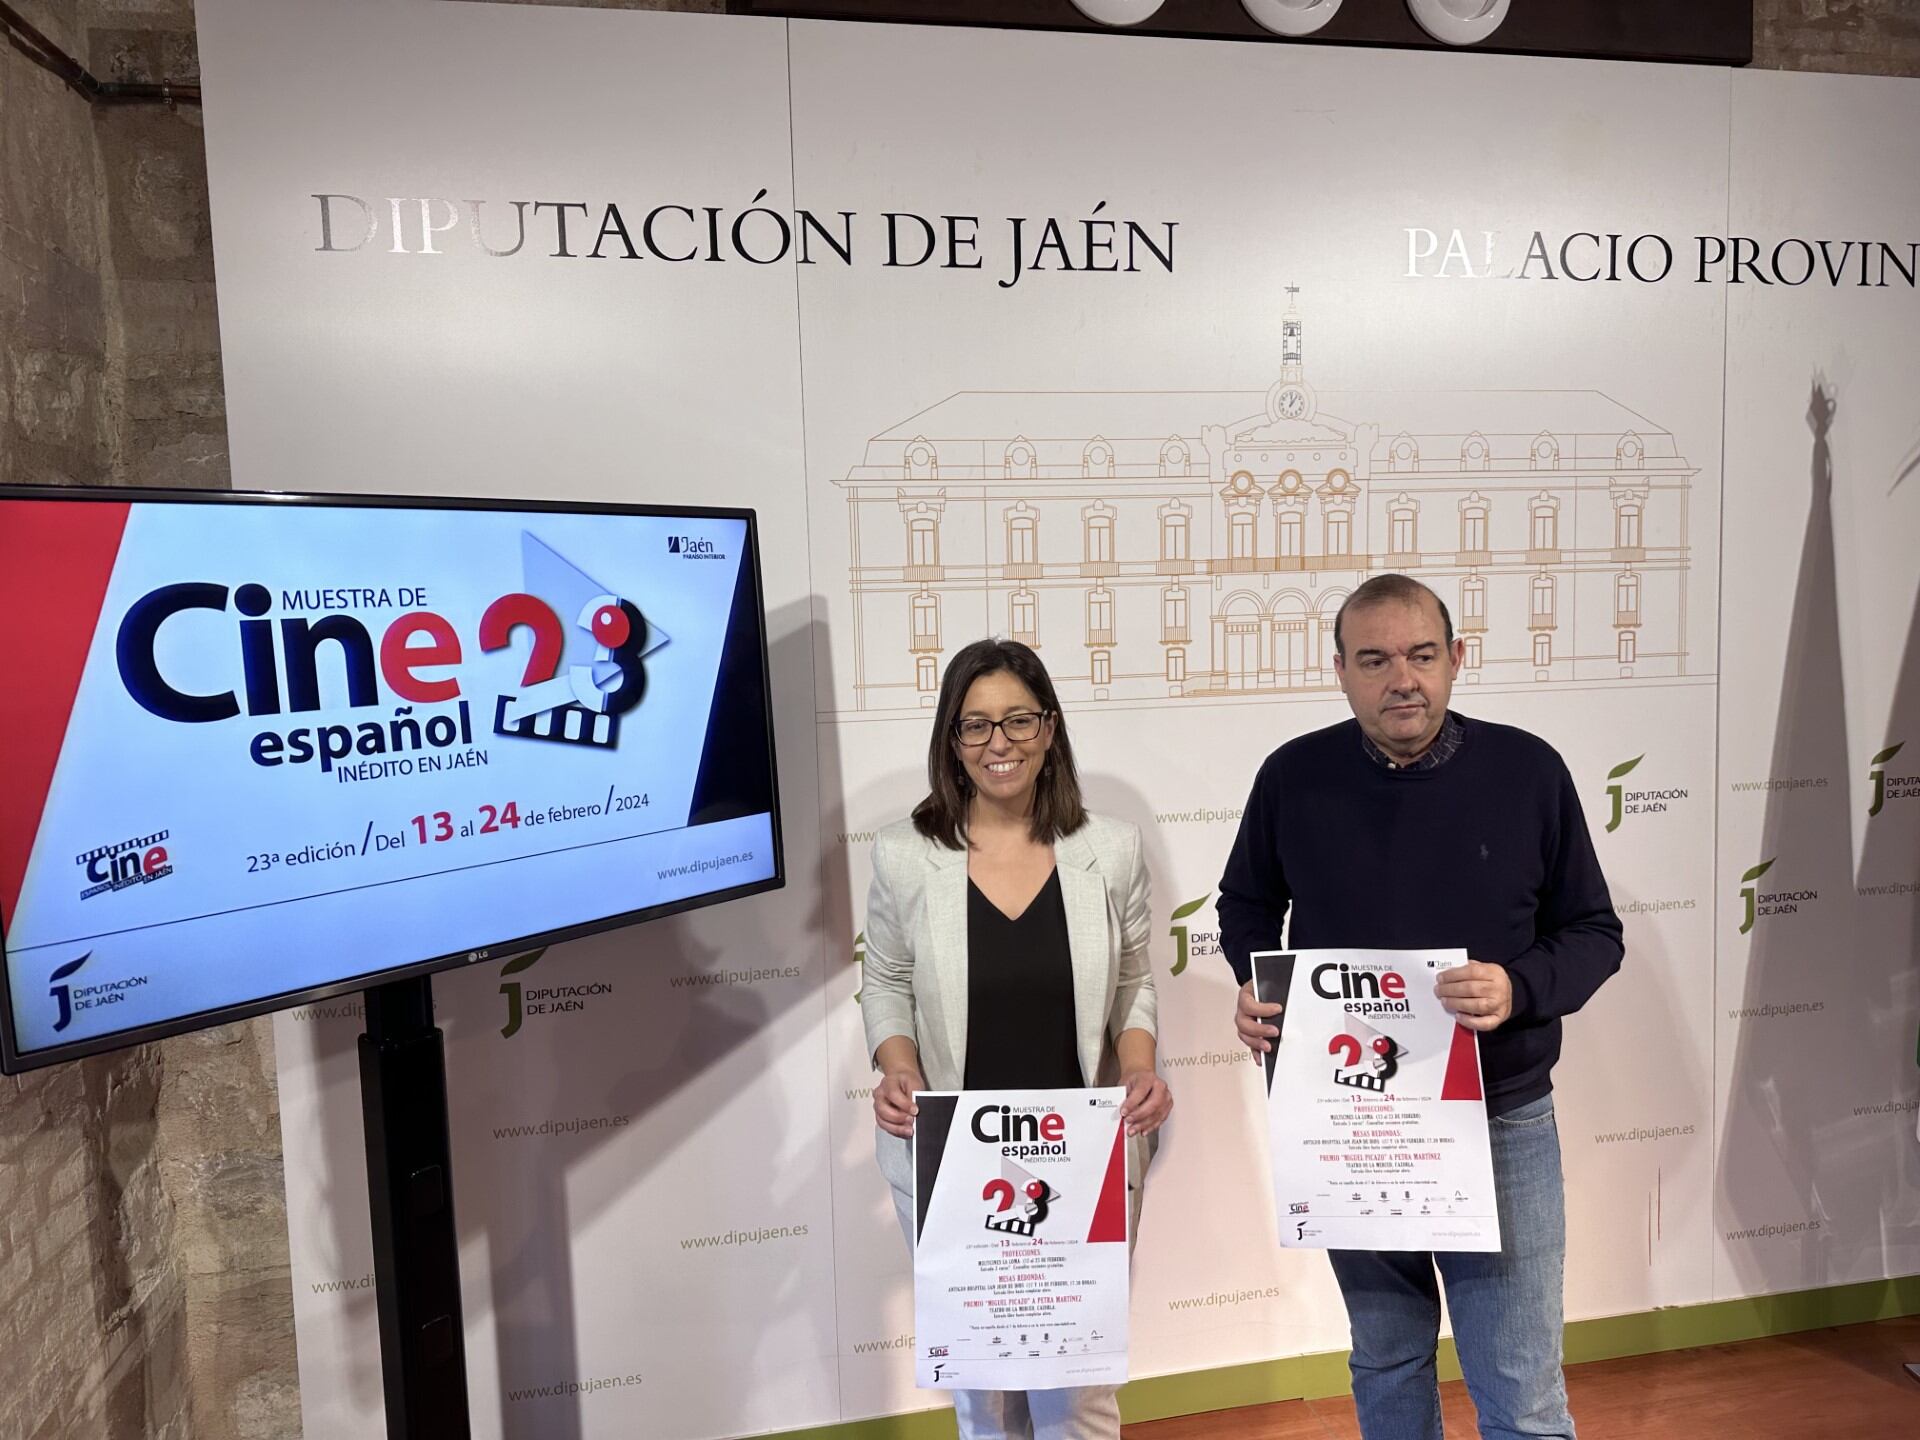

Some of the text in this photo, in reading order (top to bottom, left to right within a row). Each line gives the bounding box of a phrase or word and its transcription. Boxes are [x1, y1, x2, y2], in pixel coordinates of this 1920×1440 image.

[311, 188, 1180, 289] DIPUTACIÓN DE JAÉN
[1403, 228, 1673, 282] PALACIO
[281, 587, 427, 610] MUESTRA DE
[116, 582, 462, 723] Cine
[250, 700, 472, 773] español
[338, 748, 488, 783] INÉDITO EN JAÉN
[1731, 775, 1829, 793] www.dipujaen.es
[1624, 788, 1688, 802] DIPUTACIÓN
[1156, 808, 1243, 824] www.dipujae
[1624, 801, 1667, 814] DE JAÉN
[285, 842, 356, 866] edición
[375, 830, 406, 852] Del
[411, 811, 454, 845] 13
[460, 820, 474, 838] al
[479, 801, 521, 834] 24
[524, 810, 545, 826] de
[548, 804, 601, 823] febrero
[615, 793, 650, 812] 2024
[657, 850, 754, 881] www.dipujaen.es
[1613, 899, 1696, 915] w.dipujaen.es
[1758, 890, 1818, 903] DIPUTACIÓN
[1758, 903, 1797, 915] DE JAÉN
[1191, 932, 1222, 943] DIPU
[1191, 946, 1207, 956] DE
[73, 976, 148, 999] DIPUTACIÓN
[670, 966, 800, 988] www.dipujaen.es
[1311, 963, 1406, 999] Cine
[75, 993, 124, 1011] DE JAÉN
[526, 982, 612, 1001] DIPUTACIÓN
[527, 1000, 585, 1016] DE JAÉN
[1344, 999, 1410, 1016] español
[1728, 1000, 1825, 1019] www.dipujaen.es
[1351, 1094, 1362, 1102] 13
[1384, 1094, 1395, 1102] 24
[493, 1114, 630, 1140] www.dipujaen.es
[971, 1104, 1065, 1143] Cine
[1594, 1123, 1695, 1144] www.dipujaen.es
[1001, 1141, 1067, 1159] español
[681, 1223, 809, 1249] www.dipujaen.es
[1726, 1219, 1821, 1241] www.dipujaen.es
[1000, 1239, 1010, 1247] 13
[1032, 1238, 1043, 1246] 24
[1169, 1285, 1280, 1311] www.dipujaen.es
[508, 1371, 642, 1402] www.dipujaen.es
